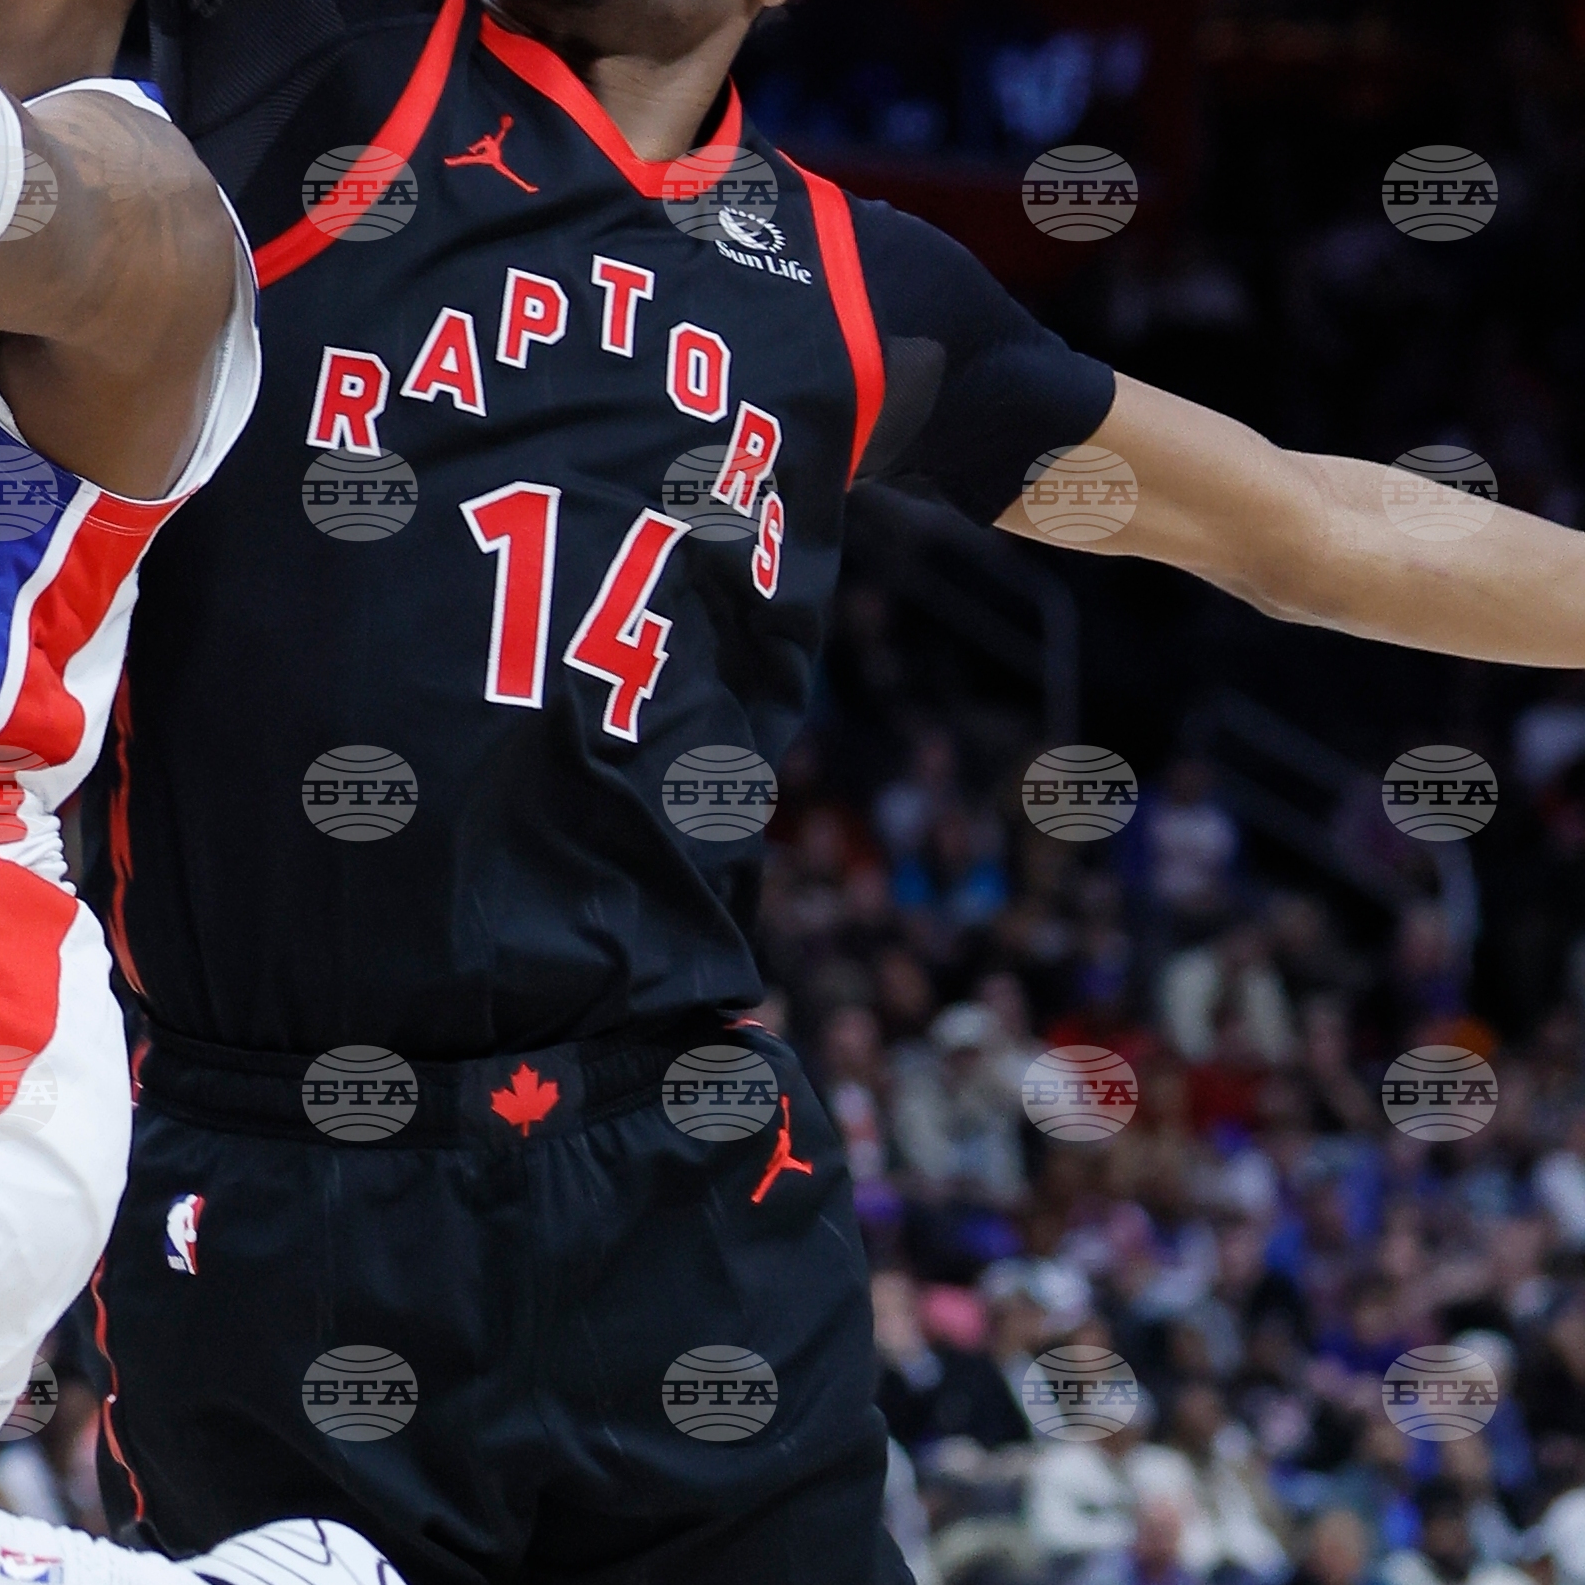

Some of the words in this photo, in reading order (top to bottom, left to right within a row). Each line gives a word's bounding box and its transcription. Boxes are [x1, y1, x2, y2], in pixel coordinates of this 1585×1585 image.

[715, 239, 764, 270] Sun
[764, 255, 812, 285] Life
[306, 254, 784, 600] RAPTORS
[458, 480, 693, 743] 14
